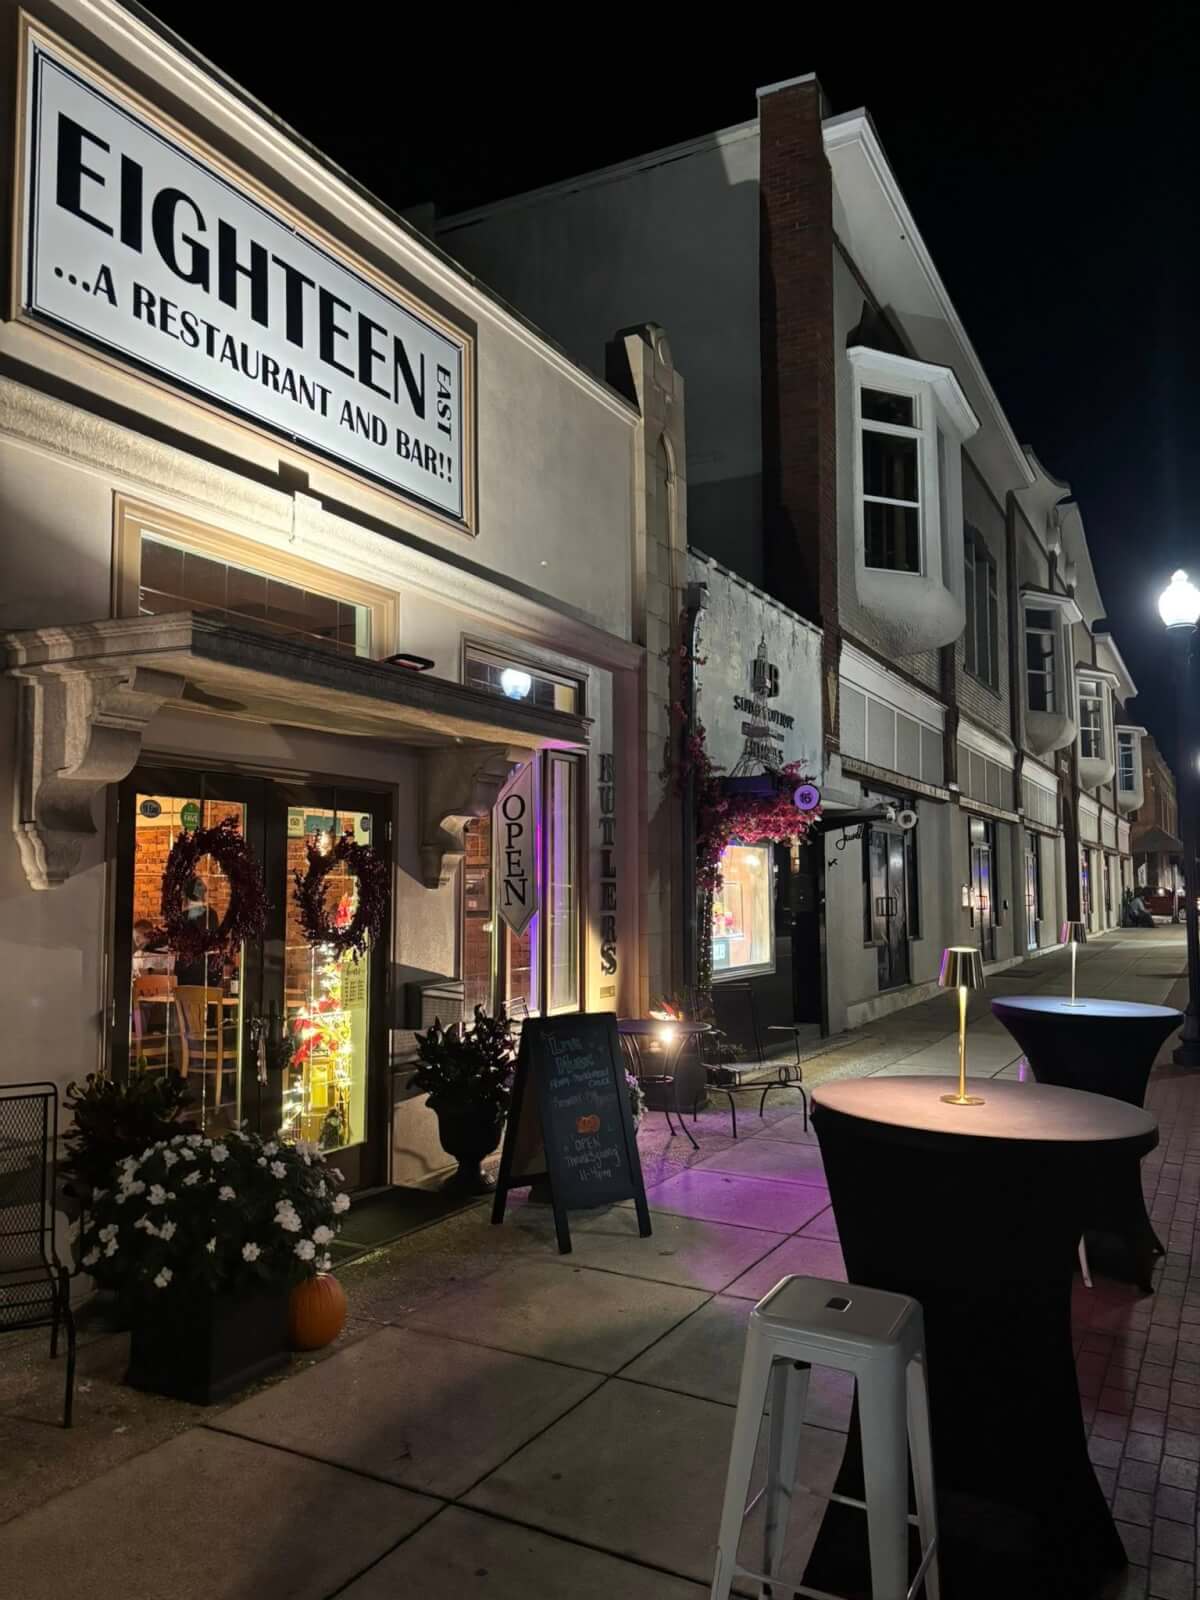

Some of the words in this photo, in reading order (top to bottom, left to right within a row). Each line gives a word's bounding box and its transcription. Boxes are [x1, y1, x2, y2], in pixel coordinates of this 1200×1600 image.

[57, 111, 426, 420] EIGHTEEN
[133, 281, 332, 418] RESTAURANT
[339, 399, 388, 449] AND
[396, 429, 453, 483] BAR!!
[437, 363, 453, 441] EAST
[502, 794, 528, 906] OPEN
[598, 753, 617, 976] BUTLERS
